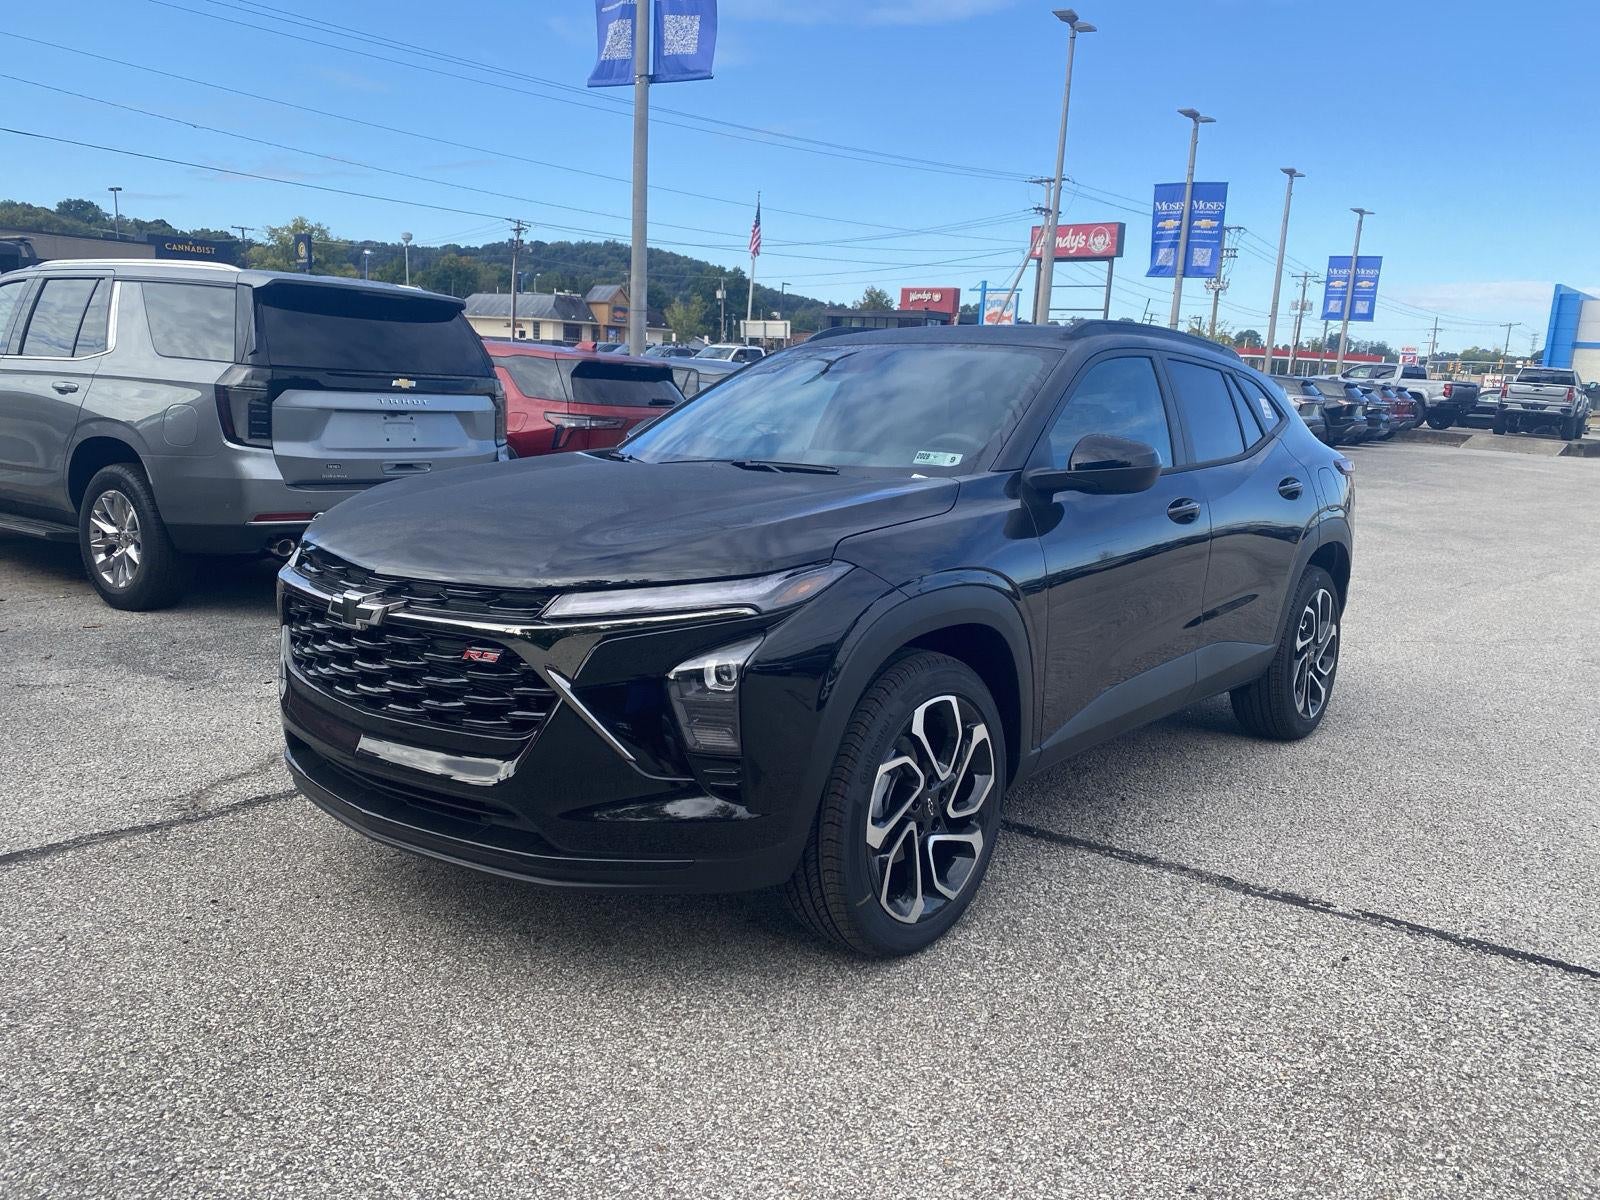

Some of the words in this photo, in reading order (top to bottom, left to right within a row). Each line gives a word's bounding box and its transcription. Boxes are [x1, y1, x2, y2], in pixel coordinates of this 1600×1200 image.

[1192, 200, 1225, 211] MOSES
[165, 242, 216, 255] CANNABIST
[909, 290, 932, 303] Wendy's
[462, 649, 501, 663] RS
